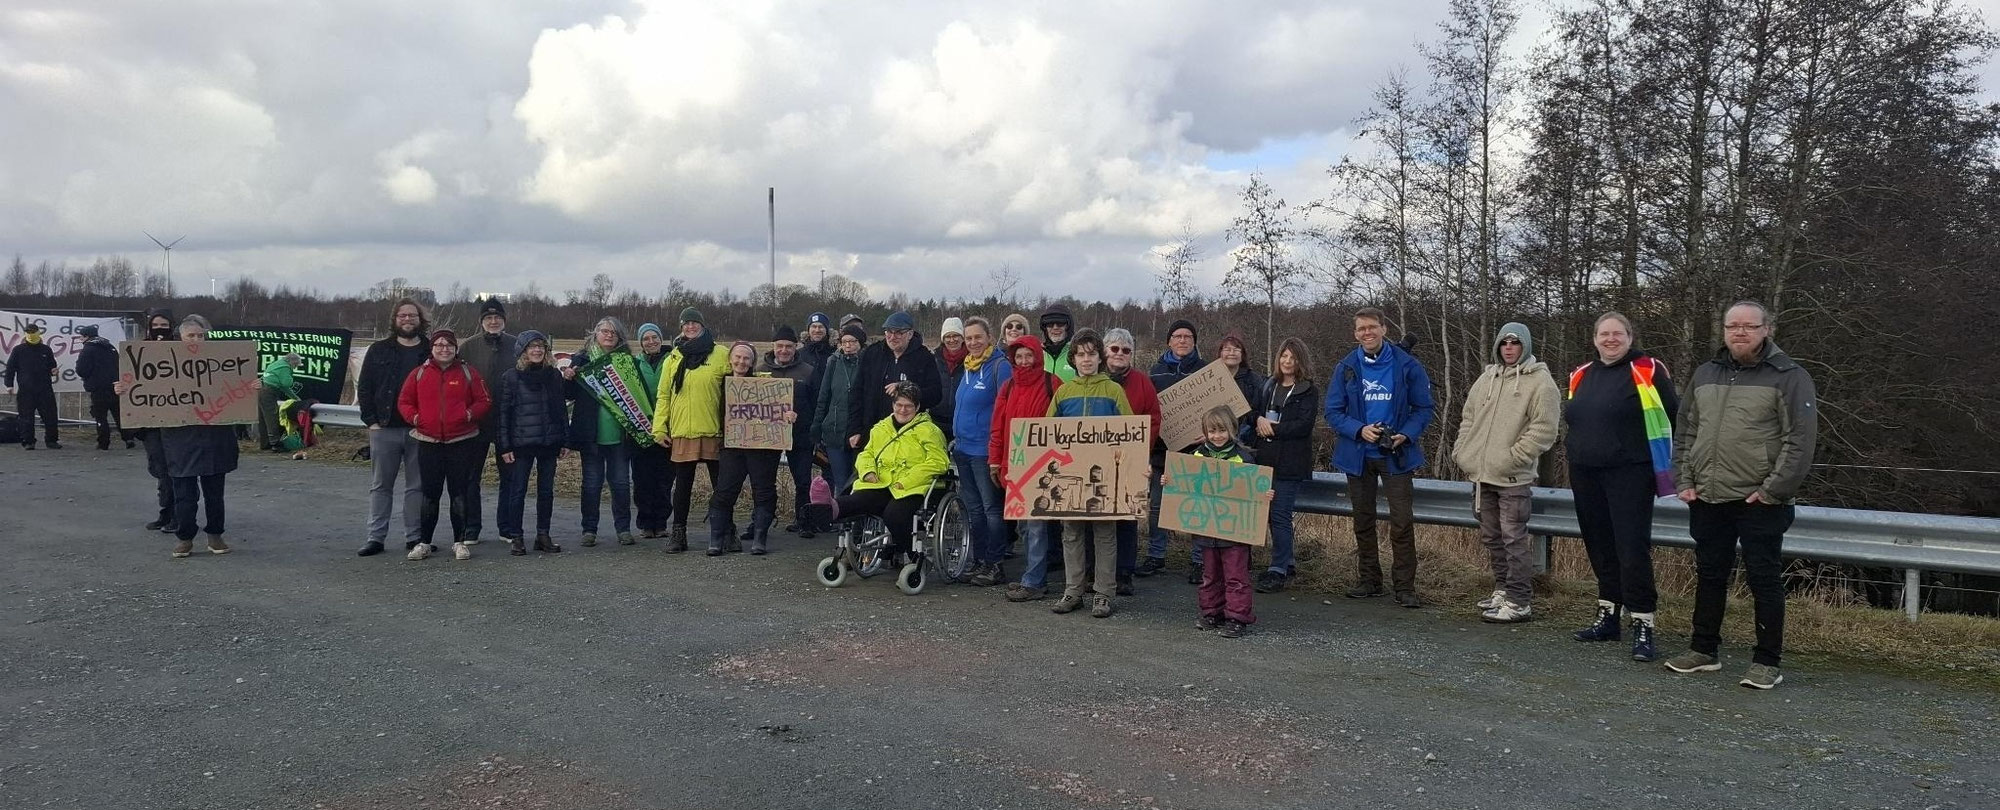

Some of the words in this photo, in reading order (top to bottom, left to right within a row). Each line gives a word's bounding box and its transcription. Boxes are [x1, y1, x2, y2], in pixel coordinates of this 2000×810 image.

[207, 330, 342, 346] NDUSTRIALISIERUNG
[126, 345, 250, 387] Voslapper
[129, 384, 204, 407] Groden
[600, 376, 620, 401] STATT
[605, 366, 628, 396] WIESEN
[624, 395, 639, 412] UND
[1365, 393, 1392, 401] NABU
[1027, 421, 1147, 449] EU-Vogelschutzgebiet
[1010, 448, 1025, 466] JA
